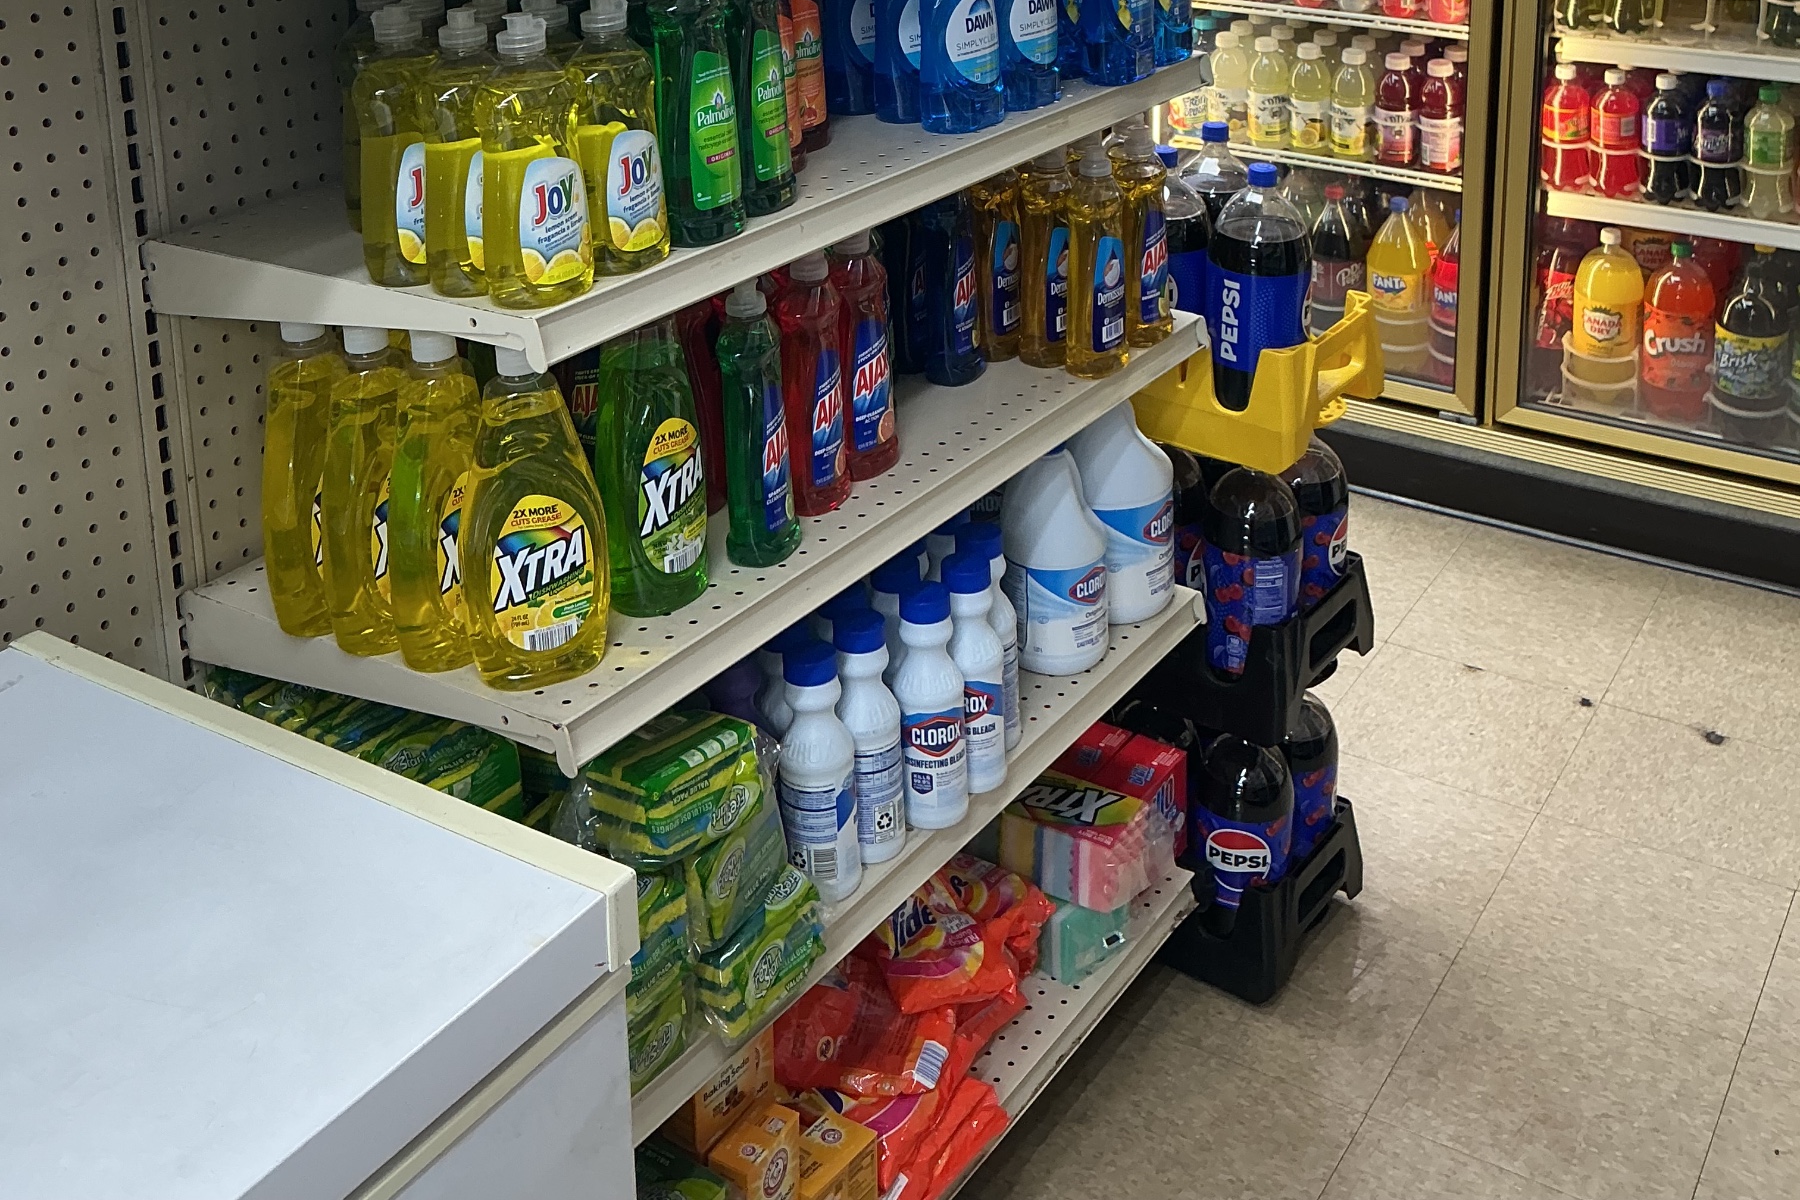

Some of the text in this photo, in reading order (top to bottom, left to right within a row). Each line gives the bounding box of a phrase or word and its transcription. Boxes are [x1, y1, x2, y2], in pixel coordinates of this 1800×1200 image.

[965, 11, 994, 34] DAWN
[697, 103, 735, 127] Palmolive
[545, 211, 578, 233] lemon scent
[538, 227, 565, 245] fragancia
[1373, 272, 1406, 289] FANTA
[1220, 278, 1241, 363] PEPSI
[1644, 329, 1706, 355] Crush
[1719, 352, 1758, 368] Brisk
[655, 426, 689, 446] 2X MORE
[653, 442, 670, 455] CUTS
[641, 445, 704, 538] XTRA
[511, 511, 563, 527] CUTS GREASE!
[513, 504, 558, 519] 2X MORE
[494, 528, 585, 612] XTRA
[532, 567, 584, 600] DISHWASHING
[911, 720, 961, 746] CLOROX
[972, 722, 996, 736] BLEACH
[1209, 847, 1269, 869] PEPSI
[703, 1056, 750, 1102] Baking Soda
